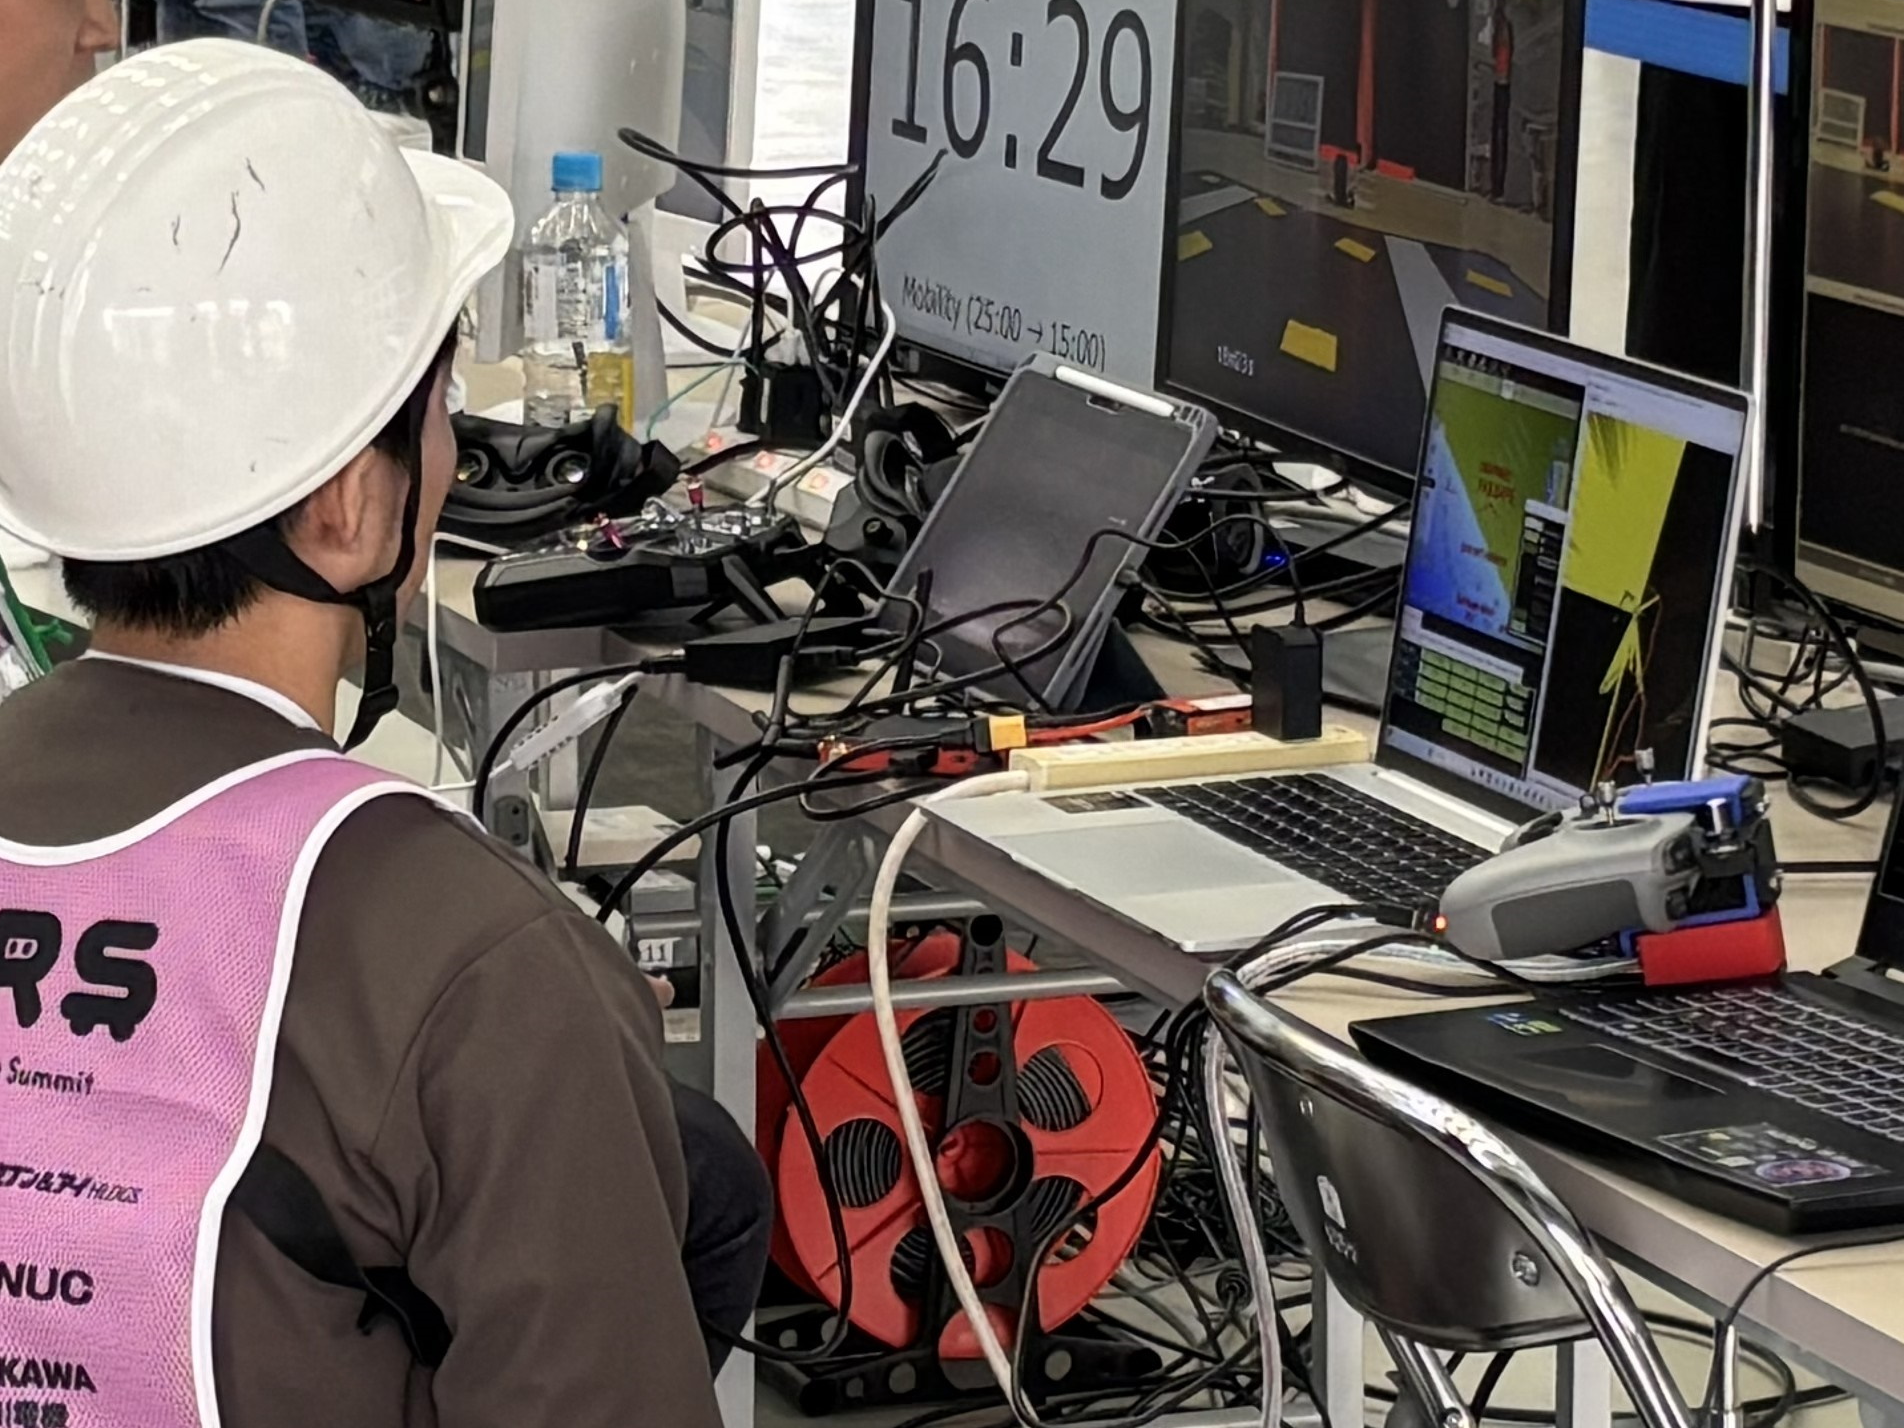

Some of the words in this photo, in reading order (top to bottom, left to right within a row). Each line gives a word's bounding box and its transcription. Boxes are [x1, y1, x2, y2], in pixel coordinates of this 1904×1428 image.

[902, 276, 962, 333] Mobility
[1050, 323, 1106, 372] 15:00)
[7, 1056, 95, 1096] Summit
